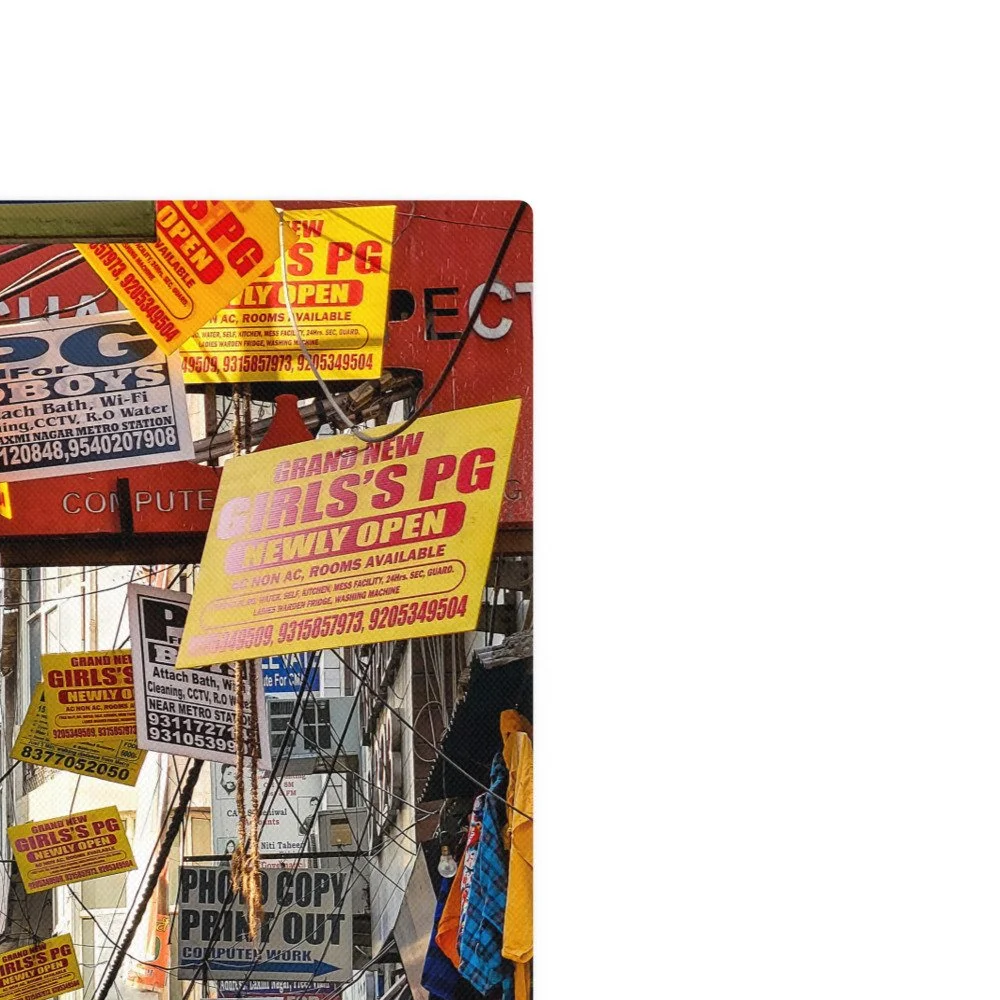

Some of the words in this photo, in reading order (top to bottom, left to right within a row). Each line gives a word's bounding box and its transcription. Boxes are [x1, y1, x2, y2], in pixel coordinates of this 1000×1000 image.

[157, 204, 215, 272] OPEN
[206, 211, 264, 278] PG
[326, 240, 384, 275] PG
[277, 282, 351, 306] OPEN
[242, 313, 285, 323] ROOMS
[8, 364, 169, 404] BOYS
[10, 365, 69, 379] For
[42, 398, 93, 416] Bath,
[100, 391, 148, 407] Wi-Fi
[120, 404, 169, 419] Water
[32, 429, 74, 442] NAGAR
[75, 423, 119, 436] METRO
[121, 415, 173, 431] STATION
[273, 445, 359, 484] GRAND
[363, 431, 424, 464] NEW
[216, 463, 409, 540] GIRLS'S
[419, 447, 496, 501] PG
[241, 525, 349, 568] NEWLY
[355, 508, 446, 548] OPEN
[309, 560, 362, 577] ROOMS
[364, 544, 446, 568] AVAILABLE
[368, 586, 400, 600] MACHINE
[368, 594, 469, 631] 9205349504
[71, 655, 110, 667] GRAND
[153, 667, 188, 683] Attach
[67, 689, 118, 702] NEWLY
[149, 700, 176, 713] NEAR
[178, 703, 212, 719] METRO
[21, 746, 130, 780] 8377052050
[15, 824, 90, 852] GIRLS'S
[92, 818, 120, 835] PG
[31, 820, 64, 834] GRAND
[66, 815, 87, 826] NEW
[34, 845, 75, 860] NEWLY
[78, 835, 111, 850] OPEN
[276, 871, 347, 908] COPY
[283, 912, 345, 945] OUT
[50, 944, 72, 960] PG
[266, 949, 312, 962] WORK
[3, 971, 35, 986] NEWLY
[37, 961, 64, 975] OPEN
